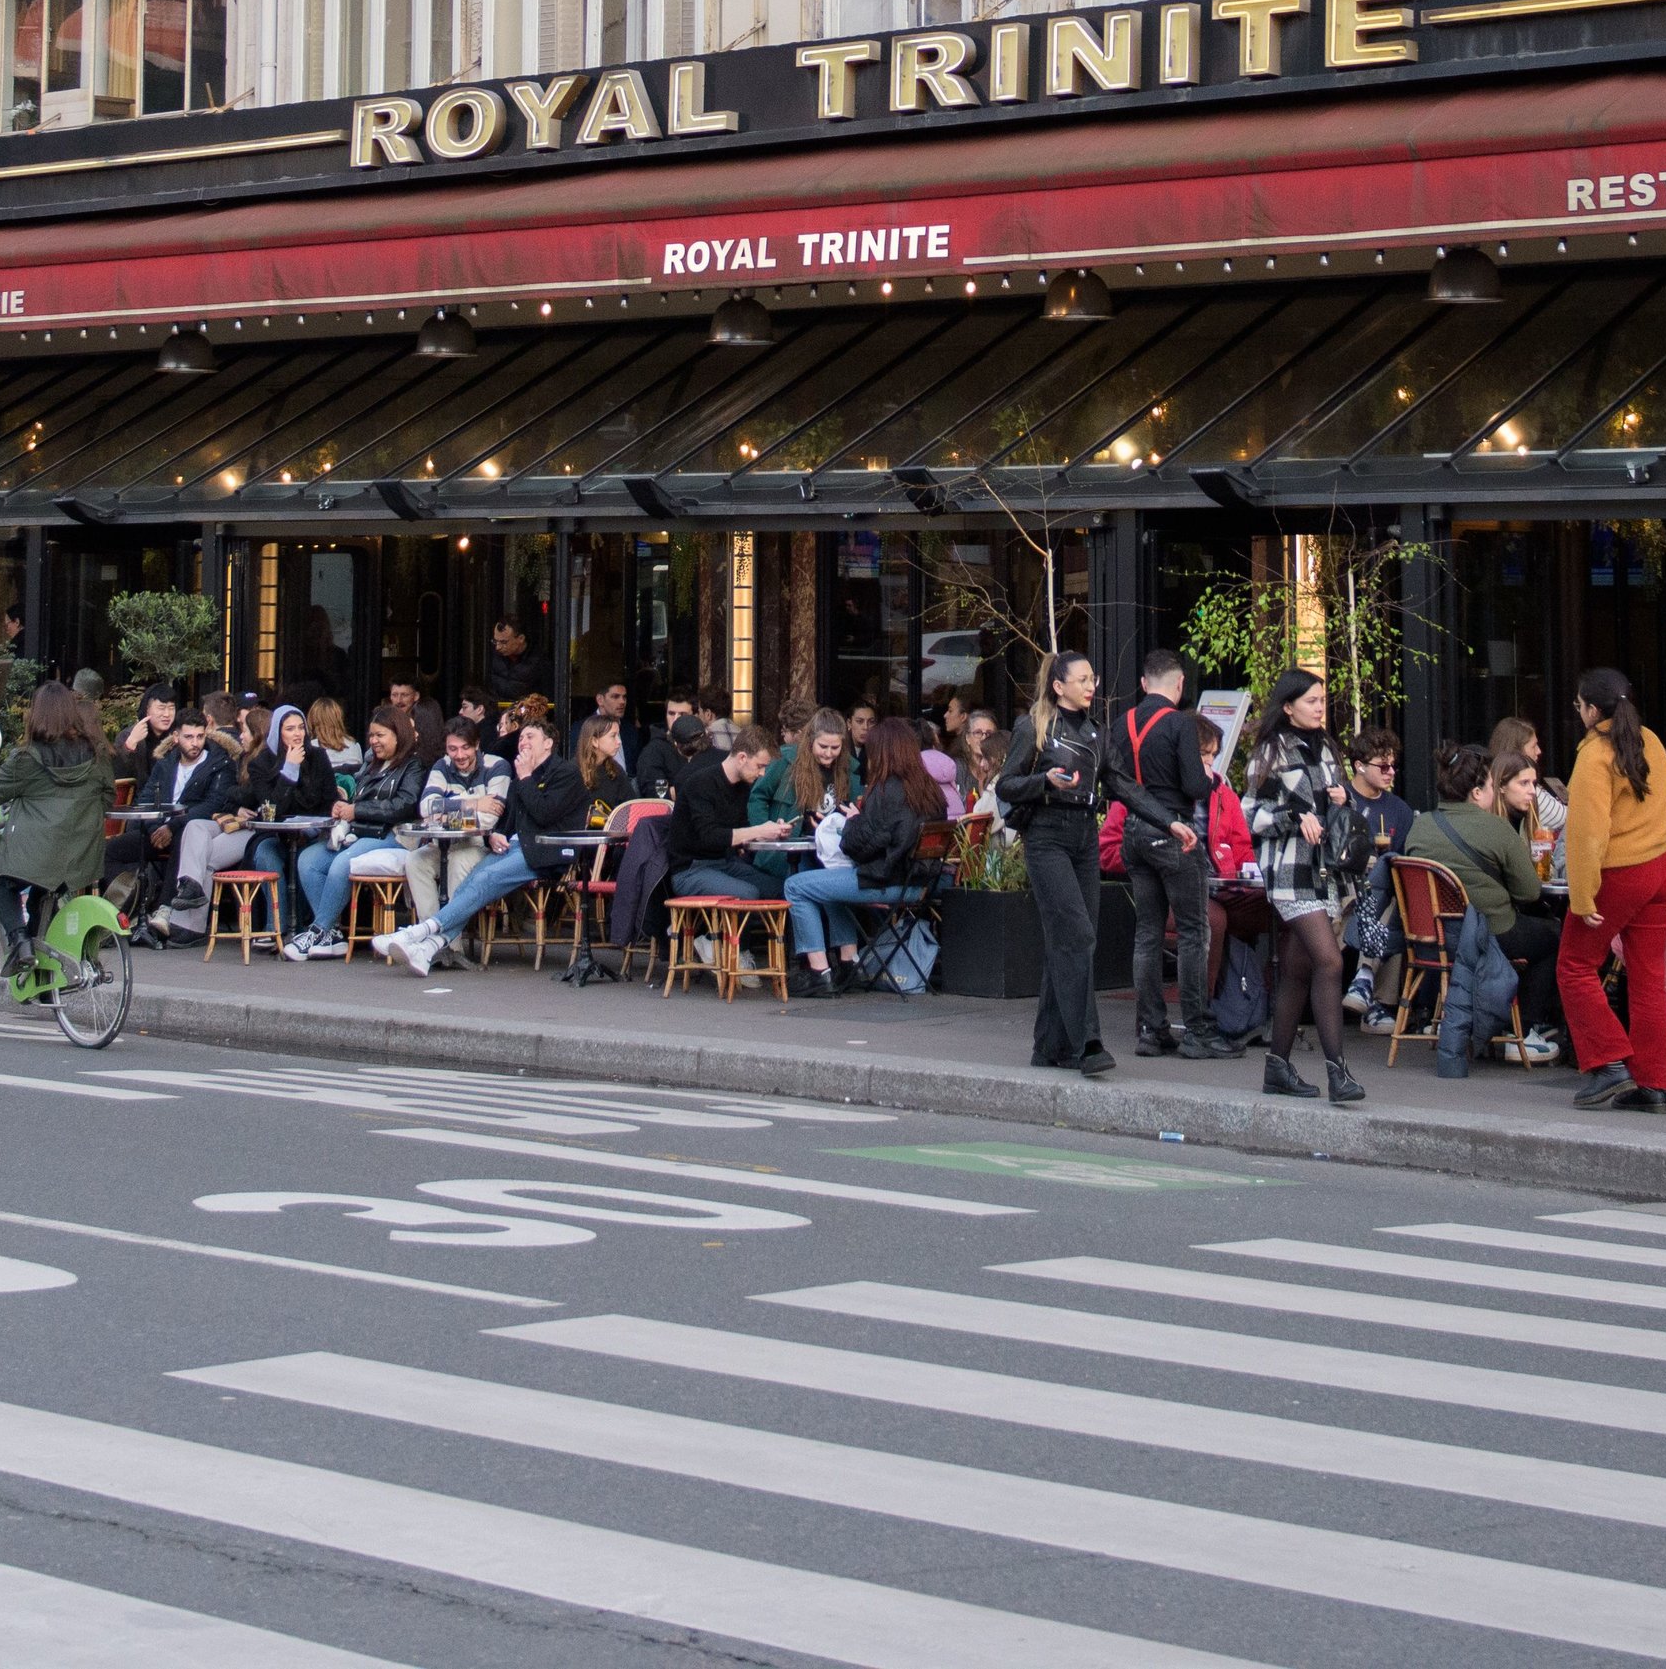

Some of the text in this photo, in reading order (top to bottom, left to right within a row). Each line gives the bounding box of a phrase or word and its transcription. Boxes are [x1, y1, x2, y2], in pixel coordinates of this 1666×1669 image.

[350, 60, 739, 169] ROYAL
[662, 224, 951, 275] ROYAL TRINITE
[76, 1067, 898, 1134] BUS
[192, 1177, 814, 1249] 30
